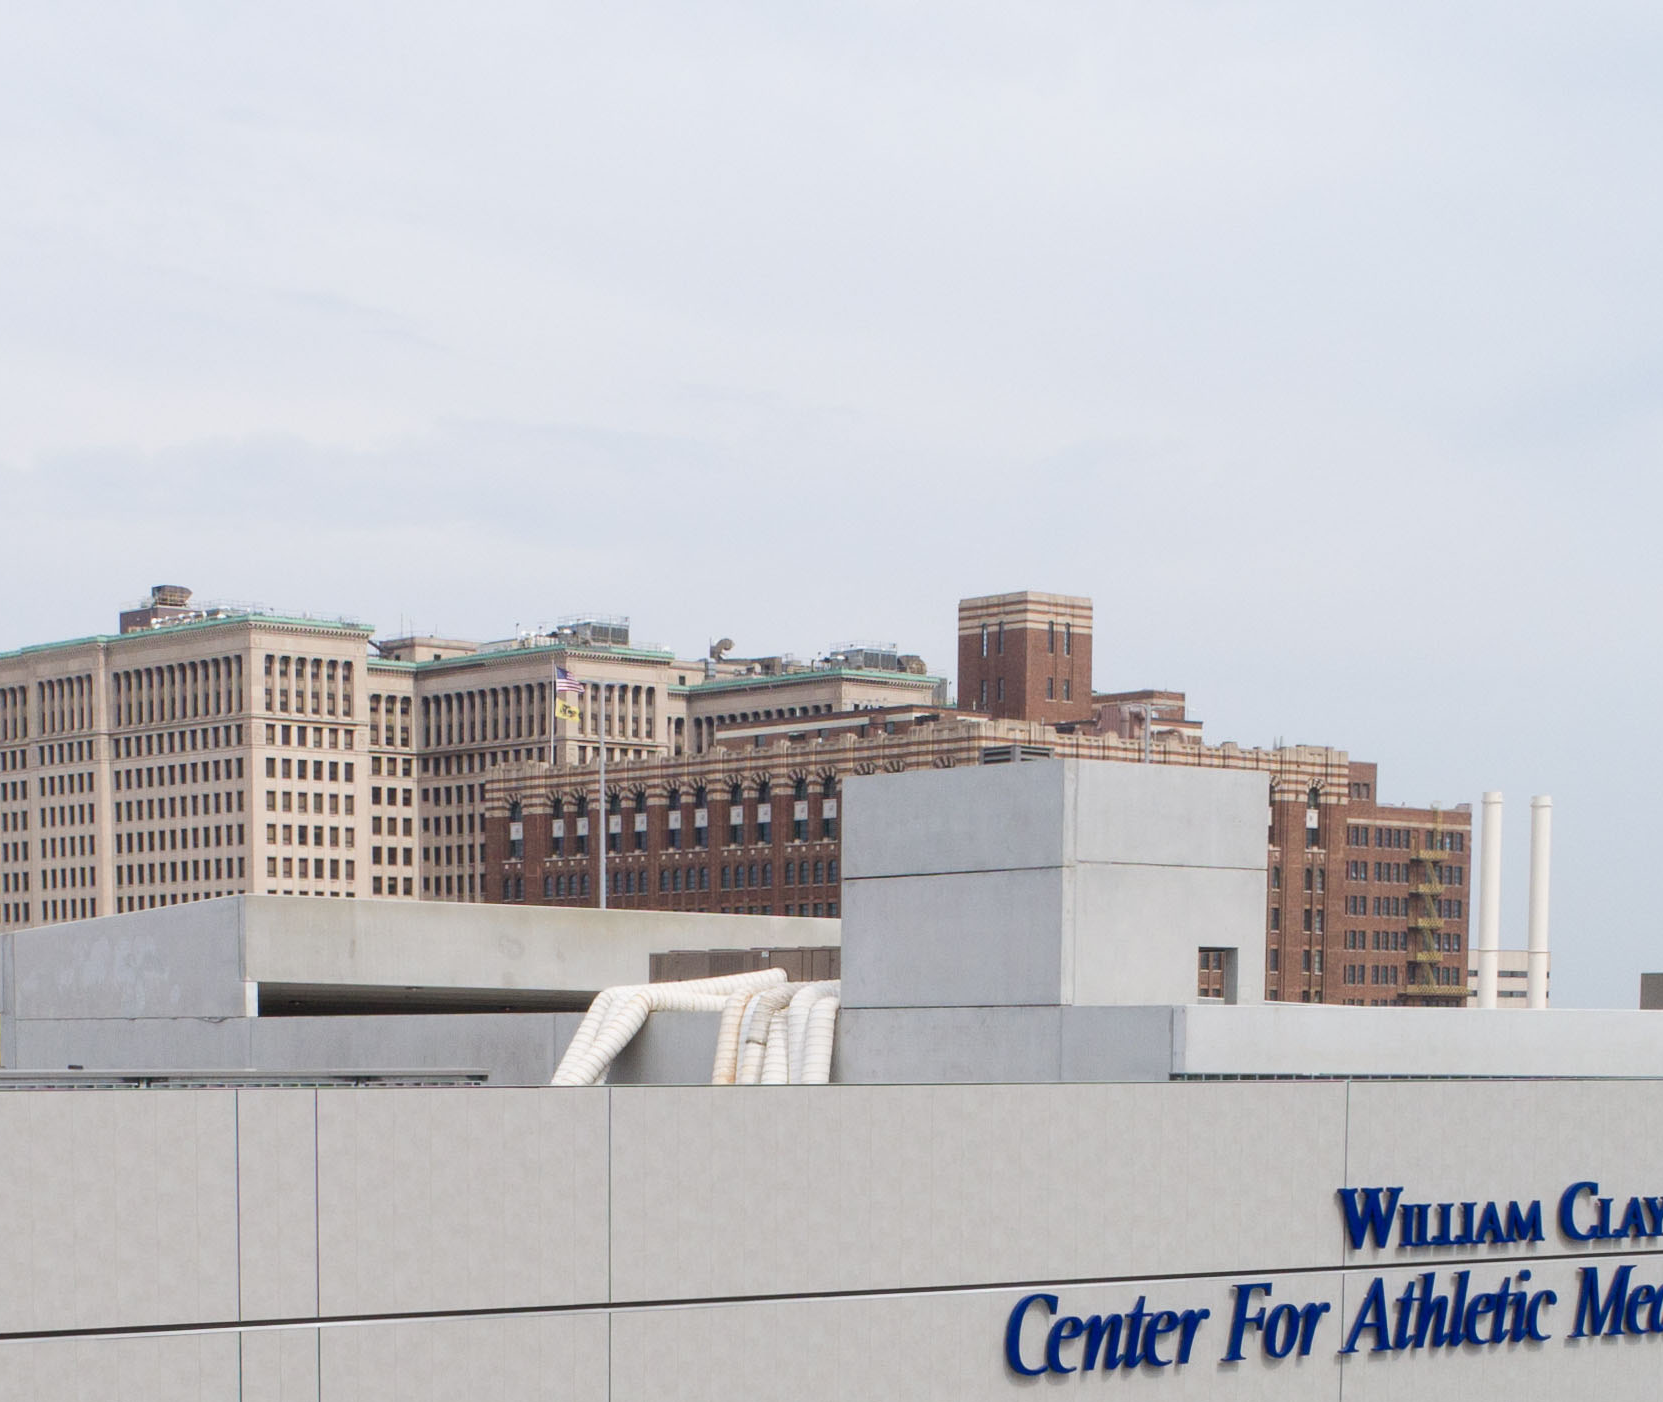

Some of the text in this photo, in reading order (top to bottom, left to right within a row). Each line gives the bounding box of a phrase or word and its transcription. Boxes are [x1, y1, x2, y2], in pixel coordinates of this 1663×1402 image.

[1336, 1186, 1545, 1250] WILLIAM
[1004, 1293, 1211, 1377] Center
[1220, 1282, 1331, 1362] For
[1337, 1268, 1558, 1354] Athletic
